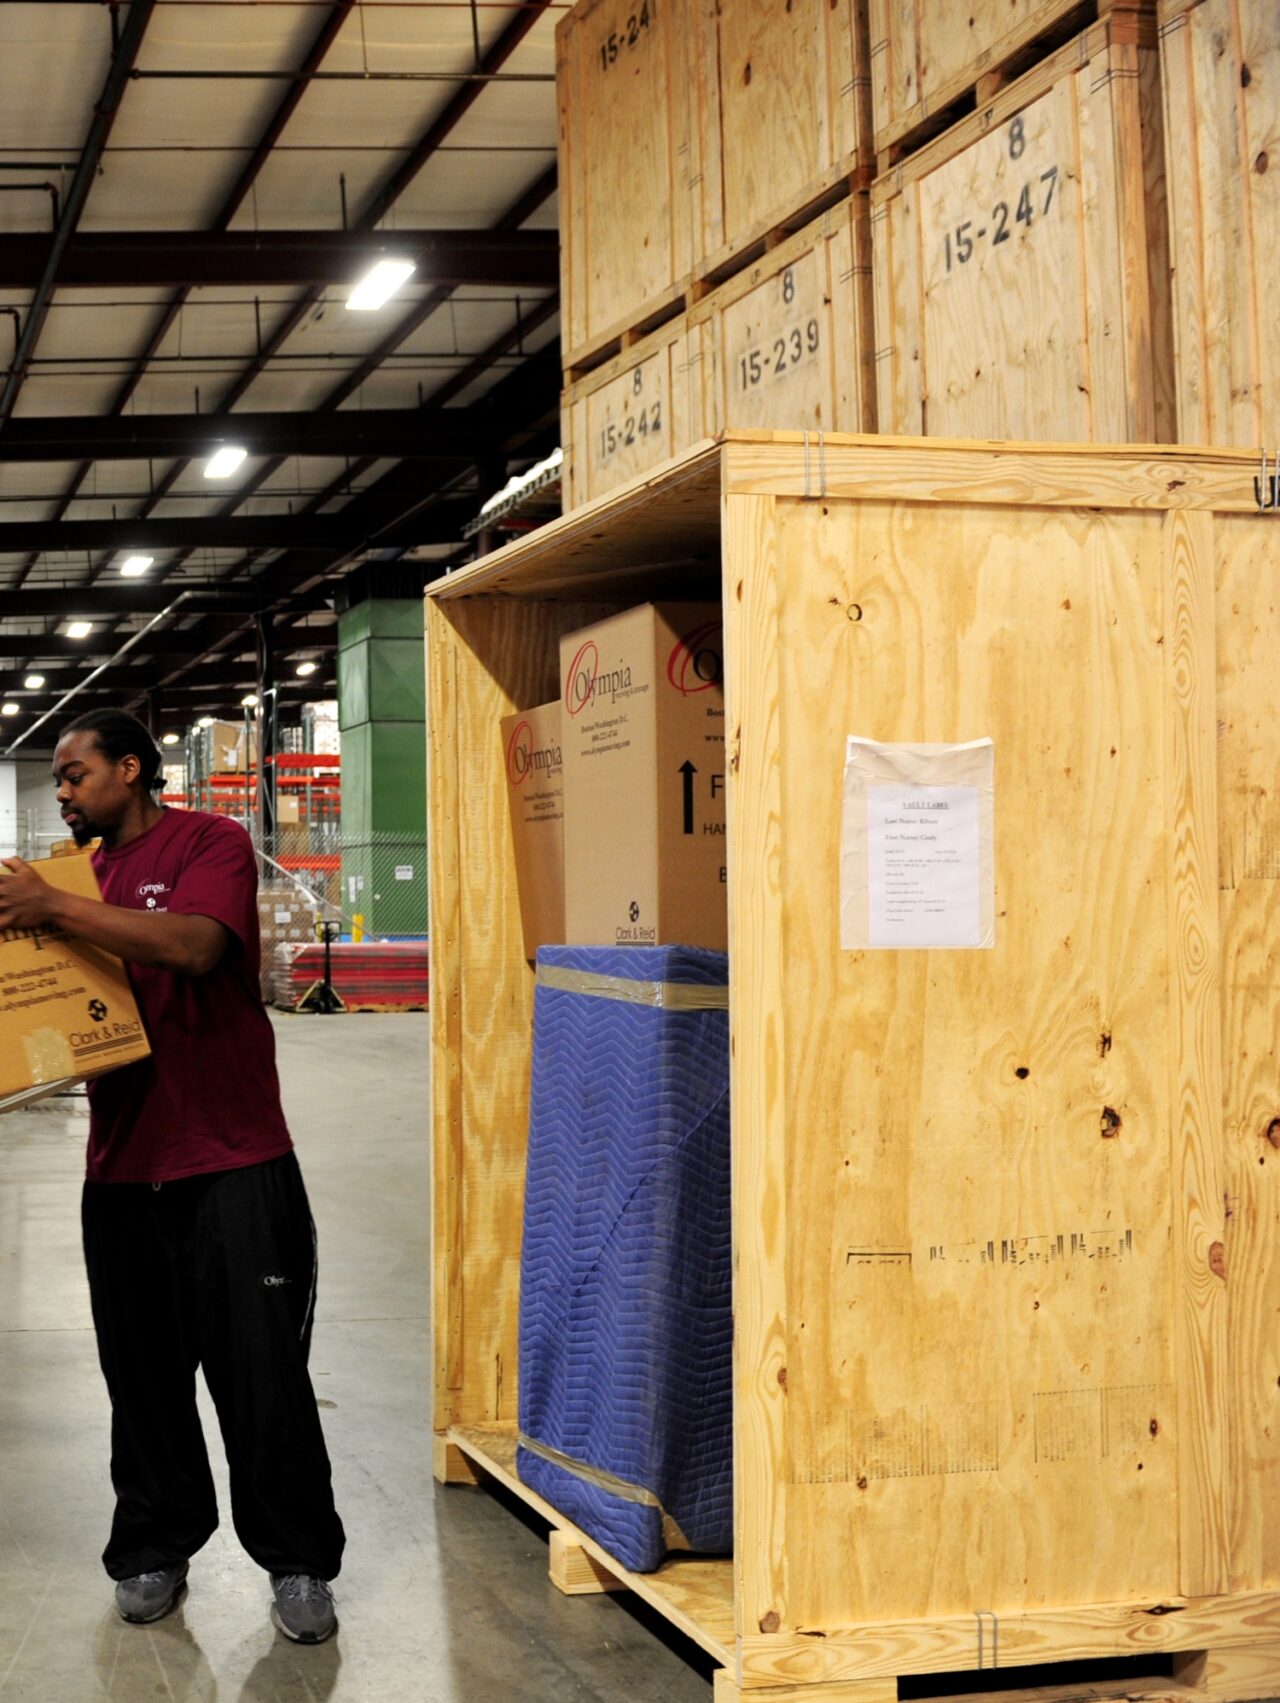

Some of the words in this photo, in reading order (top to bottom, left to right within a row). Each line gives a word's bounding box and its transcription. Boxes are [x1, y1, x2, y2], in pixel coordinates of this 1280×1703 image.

[1009, 115, 1025, 160] 8
[945, 165, 1058, 273] 15-247
[783, 269, 794, 304] 8
[741, 319, 819, 391] 15-239
[634, 367, 642, 396] 8
[601, 401, 661, 458] 15-242
[68, 1028, 103, 1048] Clark
[112, 1017, 142, 1037] Reid
